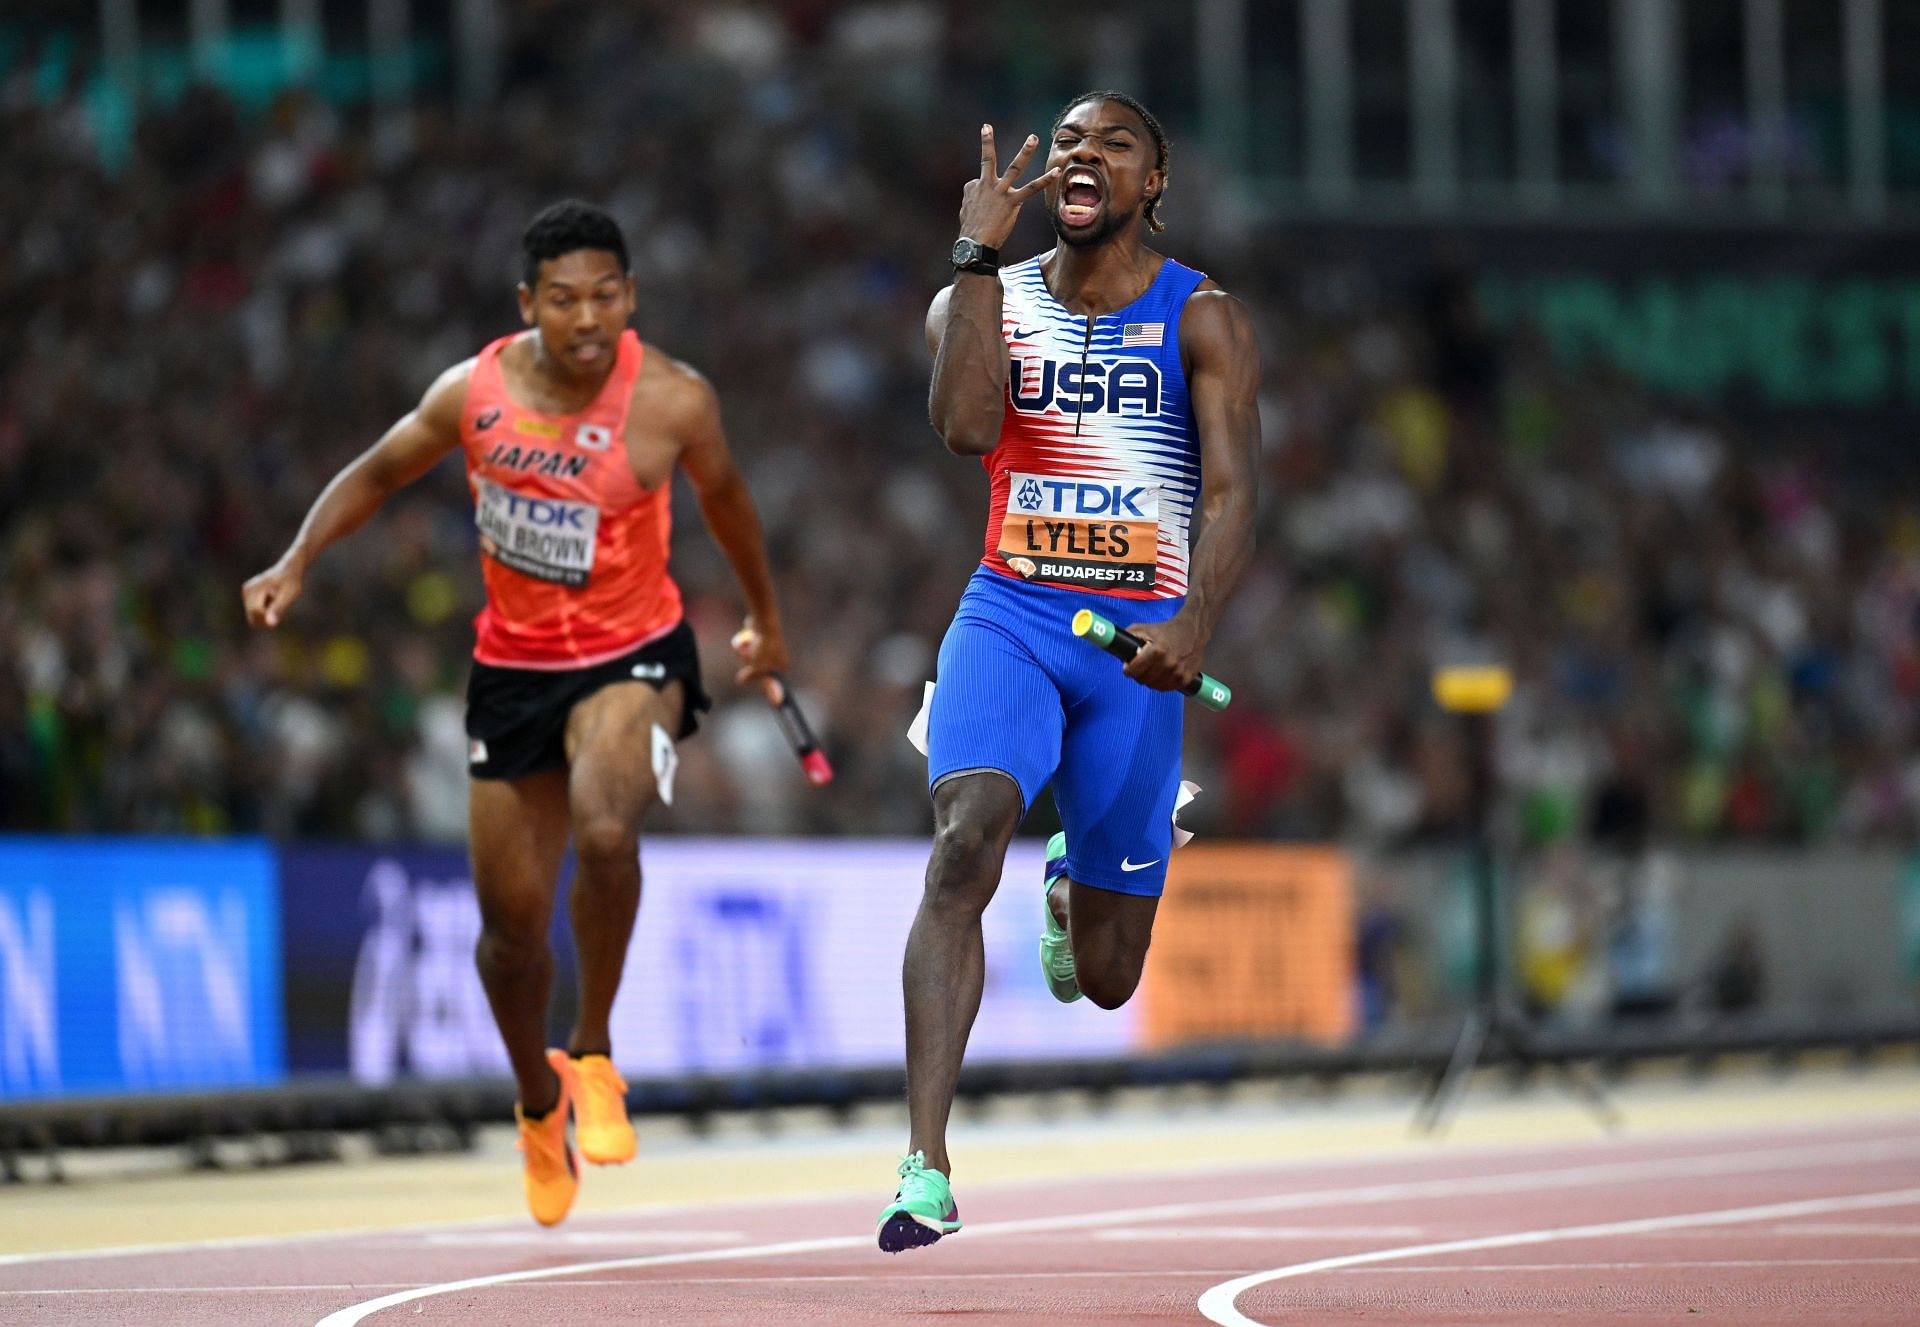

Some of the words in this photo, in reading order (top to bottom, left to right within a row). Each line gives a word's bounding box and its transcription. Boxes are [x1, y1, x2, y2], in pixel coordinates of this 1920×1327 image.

[1009, 357, 1161, 416] USA
[485, 444, 588, 477] JAPAN
[504, 493, 586, 531] TDK
[1043, 480, 1146, 517] TDK
[514, 525, 587, 562] BROWN
[1026, 519, 1130, 558] LYLES
[1040, 563, 1125, 582] BUDAPEST
[1126, 570, 1145, 582] 23
[1093, 620, 1106, 637] 8
[1212, 687, 1225, 702] 8
